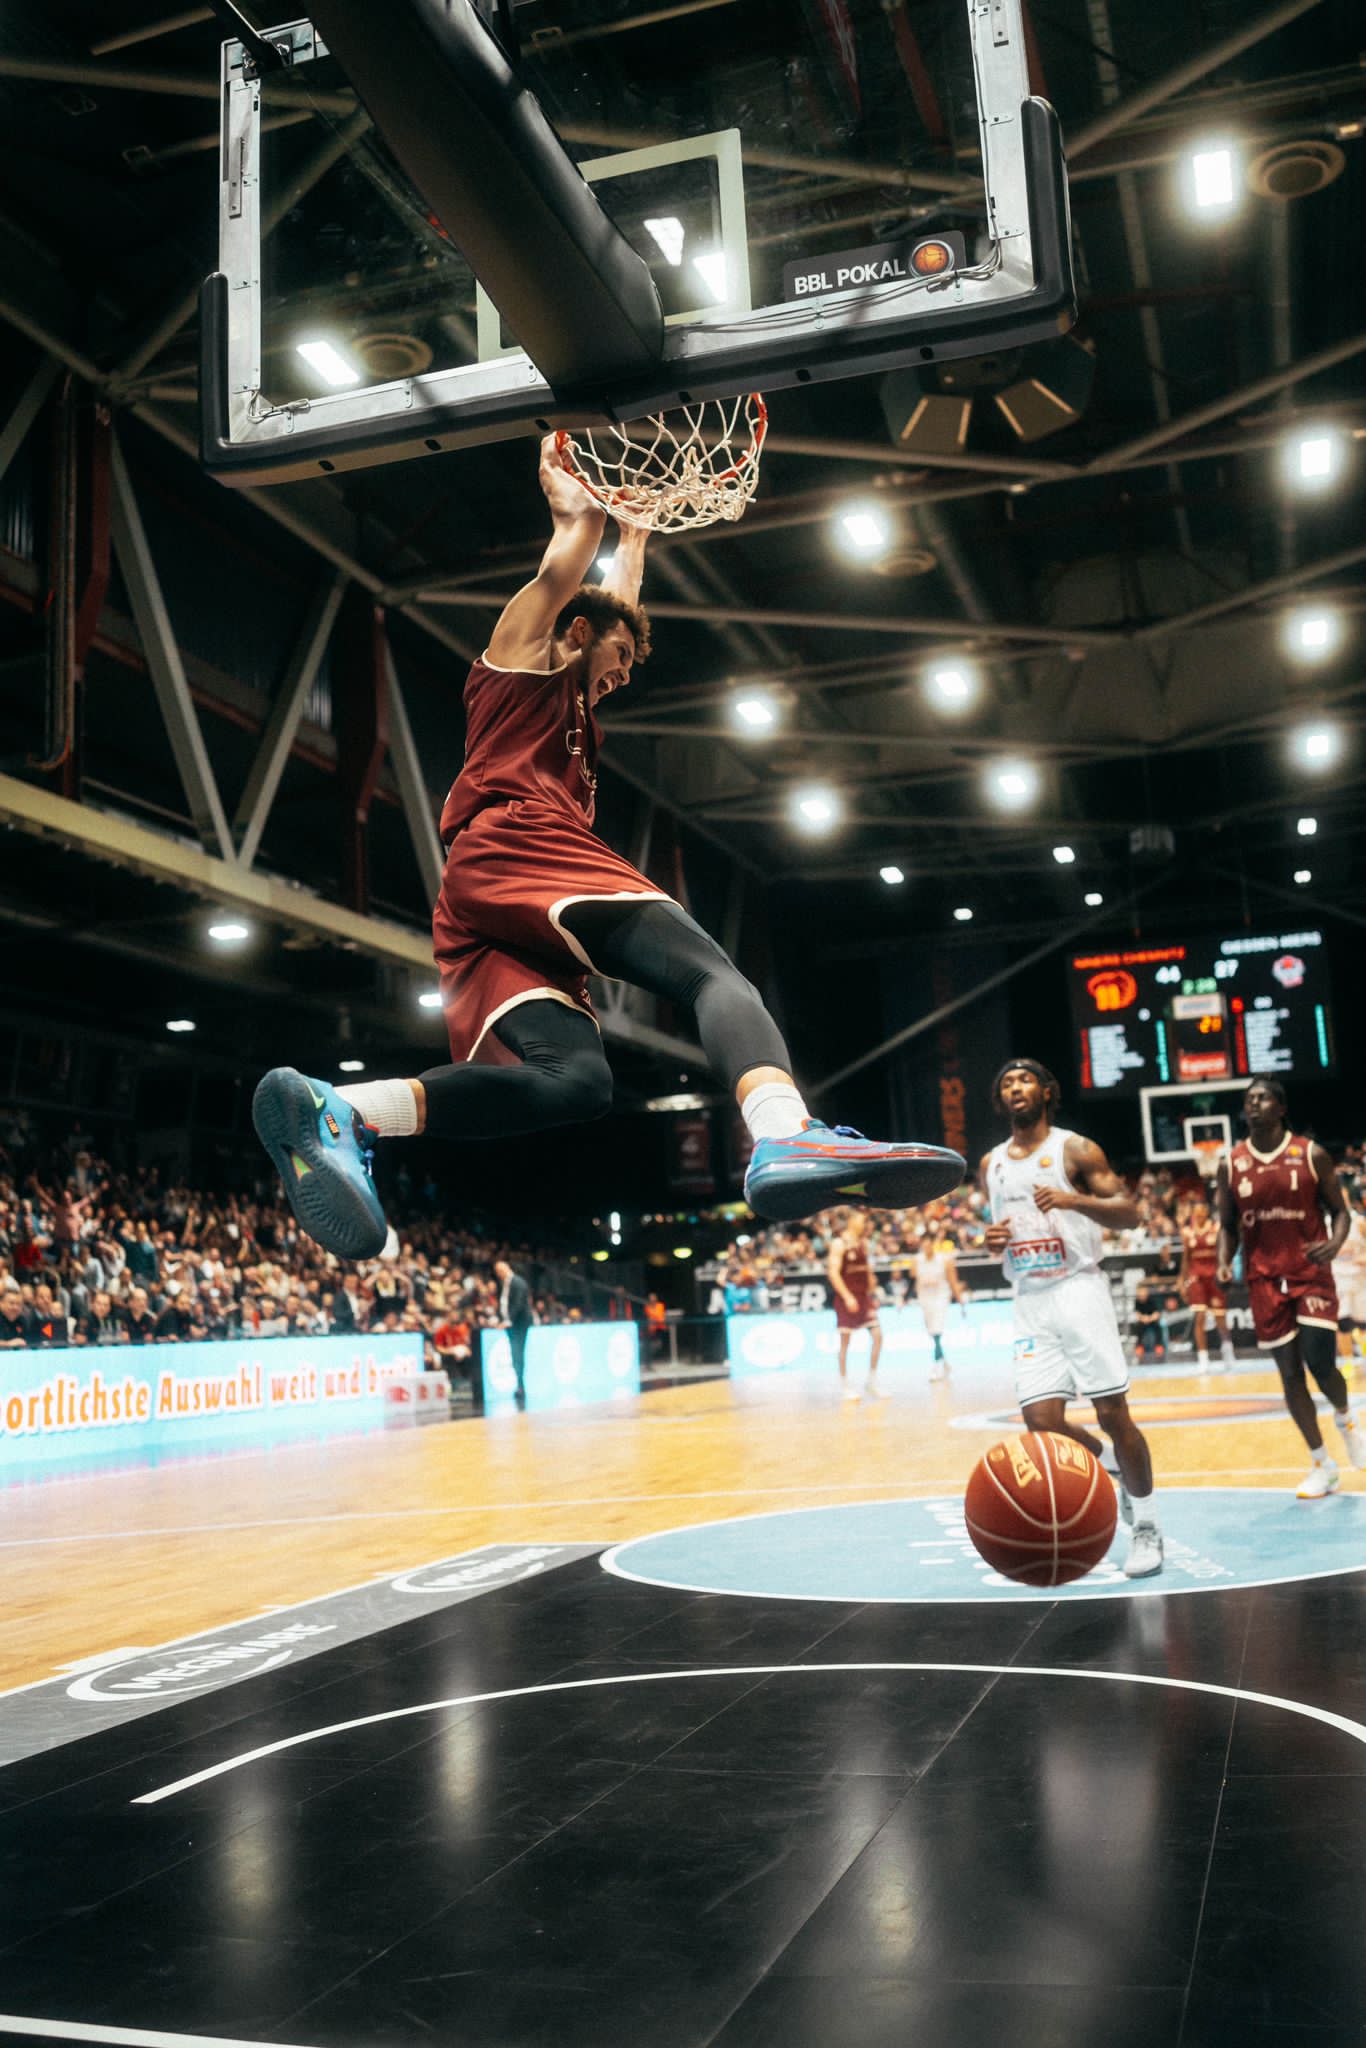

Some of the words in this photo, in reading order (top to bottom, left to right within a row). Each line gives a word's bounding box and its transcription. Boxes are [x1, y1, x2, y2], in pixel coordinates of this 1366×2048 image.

[794, 273, 833, 295] BBL
[837, 259, 906, 287] POKAL
[160, 1366, 262, 1413] Auswahl
[271, 1368, 316, 1401] weit
[109, 1623, 338, 1689] MEGWARE
